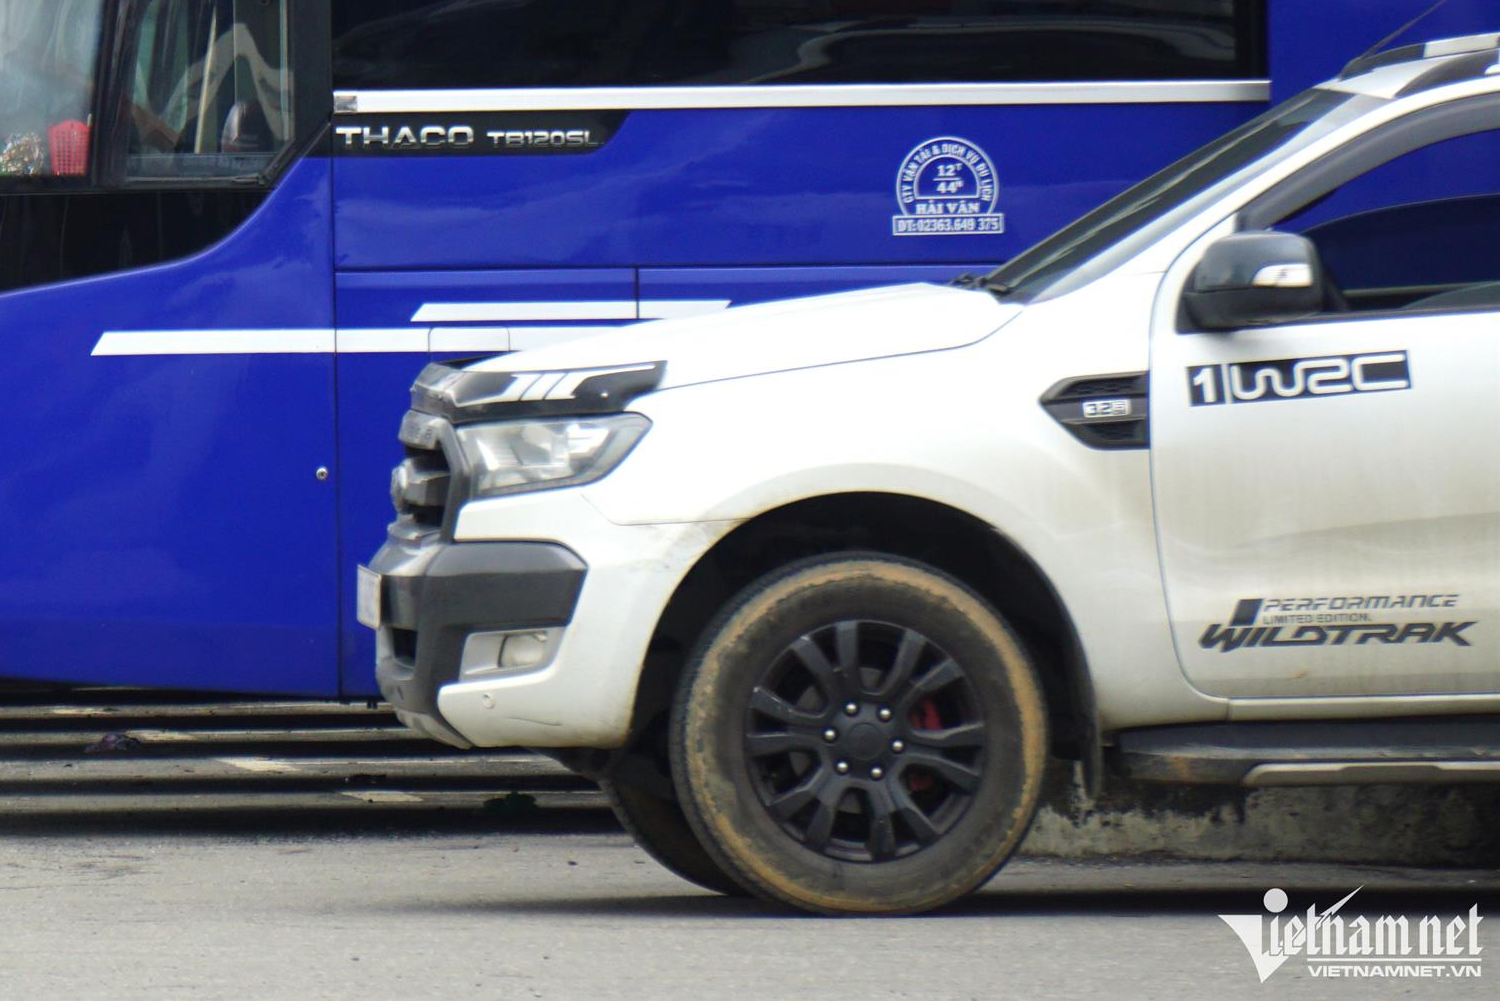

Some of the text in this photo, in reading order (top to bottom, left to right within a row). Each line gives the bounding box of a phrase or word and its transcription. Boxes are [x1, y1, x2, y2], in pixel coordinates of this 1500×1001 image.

[335, 126, 474, 147] THACO
[1263, 594, 1460, 612] PERFORMANCE
[1263, 613, 1312, 625] LIMITED
[1198, 621, 1478, 653] WILDTRAK
